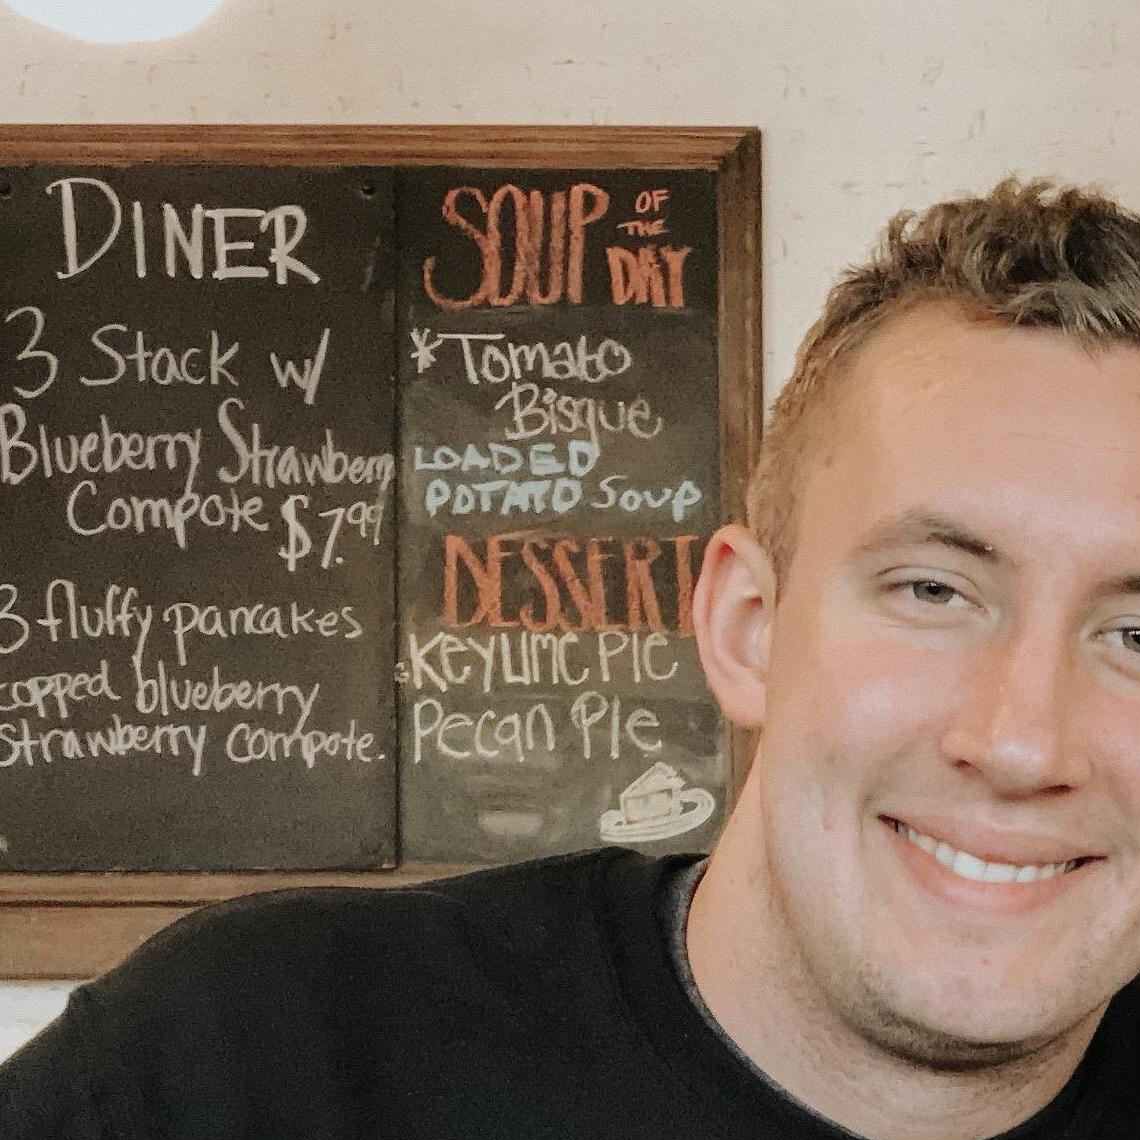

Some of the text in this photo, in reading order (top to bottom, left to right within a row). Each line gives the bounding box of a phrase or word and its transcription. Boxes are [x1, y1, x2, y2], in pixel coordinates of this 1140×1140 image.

[45, 177, 321, 285] DINER
[422, 183, 692, 311] SOUP OF THE DAY
[5, 306, 331, 405] 3 Stack w/
[437, 333, 633, 385] Tomato
[0, 402, 201, 497] Blueberry
[415, 440, 600, 477] LOADED
[67, 480, 269, 549] Compote
[425, 477, 582, 516] POTATO
[0, 579, 364, 667] 3 fluffy pancakes
[443, 530, 702, 639] DESSERT
[131, 654, 321, 735] blueberry
[413, 697, 556, 764] Pecan
